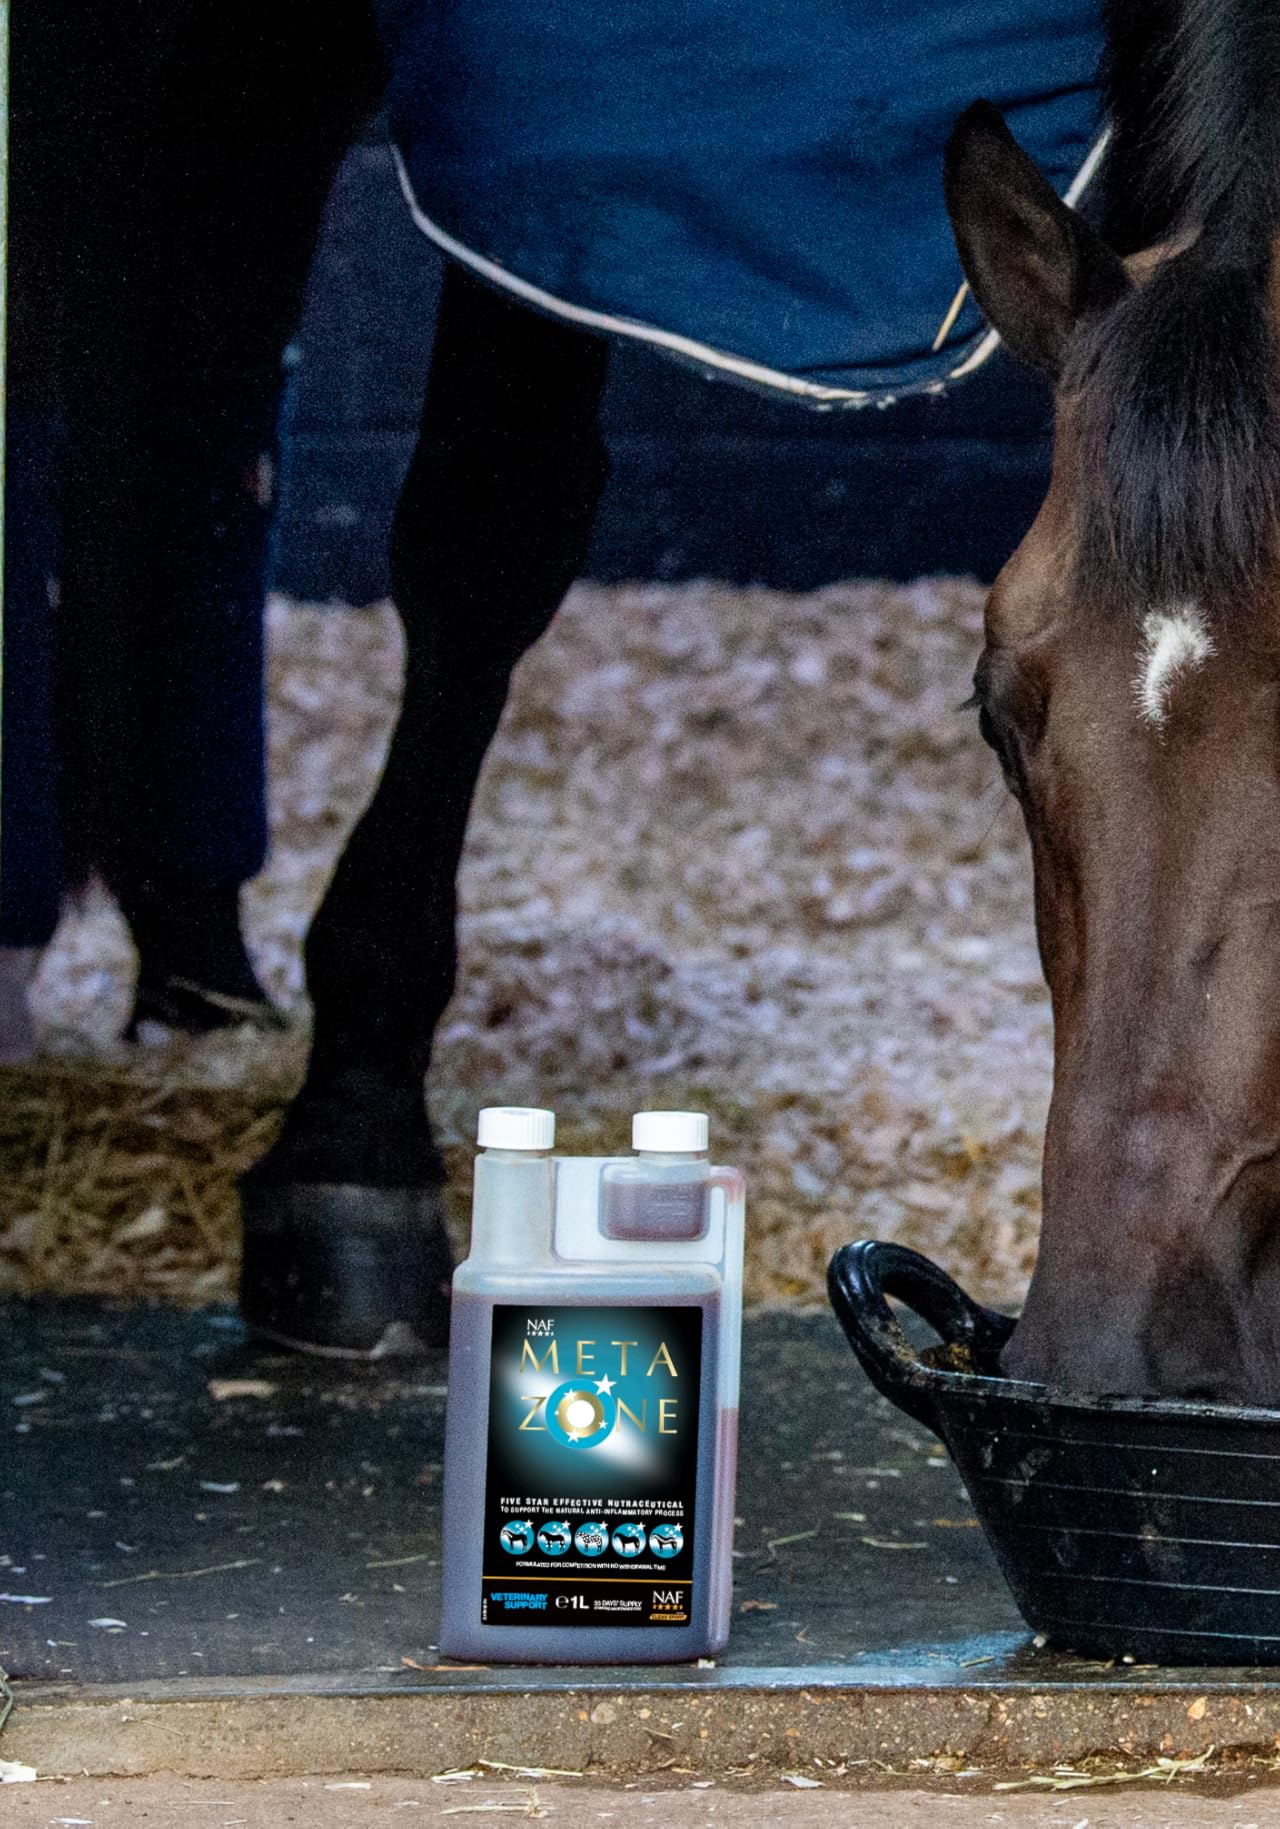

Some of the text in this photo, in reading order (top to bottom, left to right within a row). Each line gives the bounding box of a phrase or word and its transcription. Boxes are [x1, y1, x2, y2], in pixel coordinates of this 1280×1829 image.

[527, 1319, 555, 1330] NAF
[519, 1339, 678, 1376] META
[518, 1391, 678, 1438] ZONE
[500, 1497, 684, 1508] FIVE STAR EFFECTIVE NUTRACEUTICAL
[586, 1508, 652, 1516] ANTI-INFLAMMATORY
[654, 1509, 684, 1517] PROCESS
[490, 1592, 548, 1601] VETERINARY
[652, 1590, 684, 1604] NAF
[504, 1601, 548, 1610] SUPPORT
